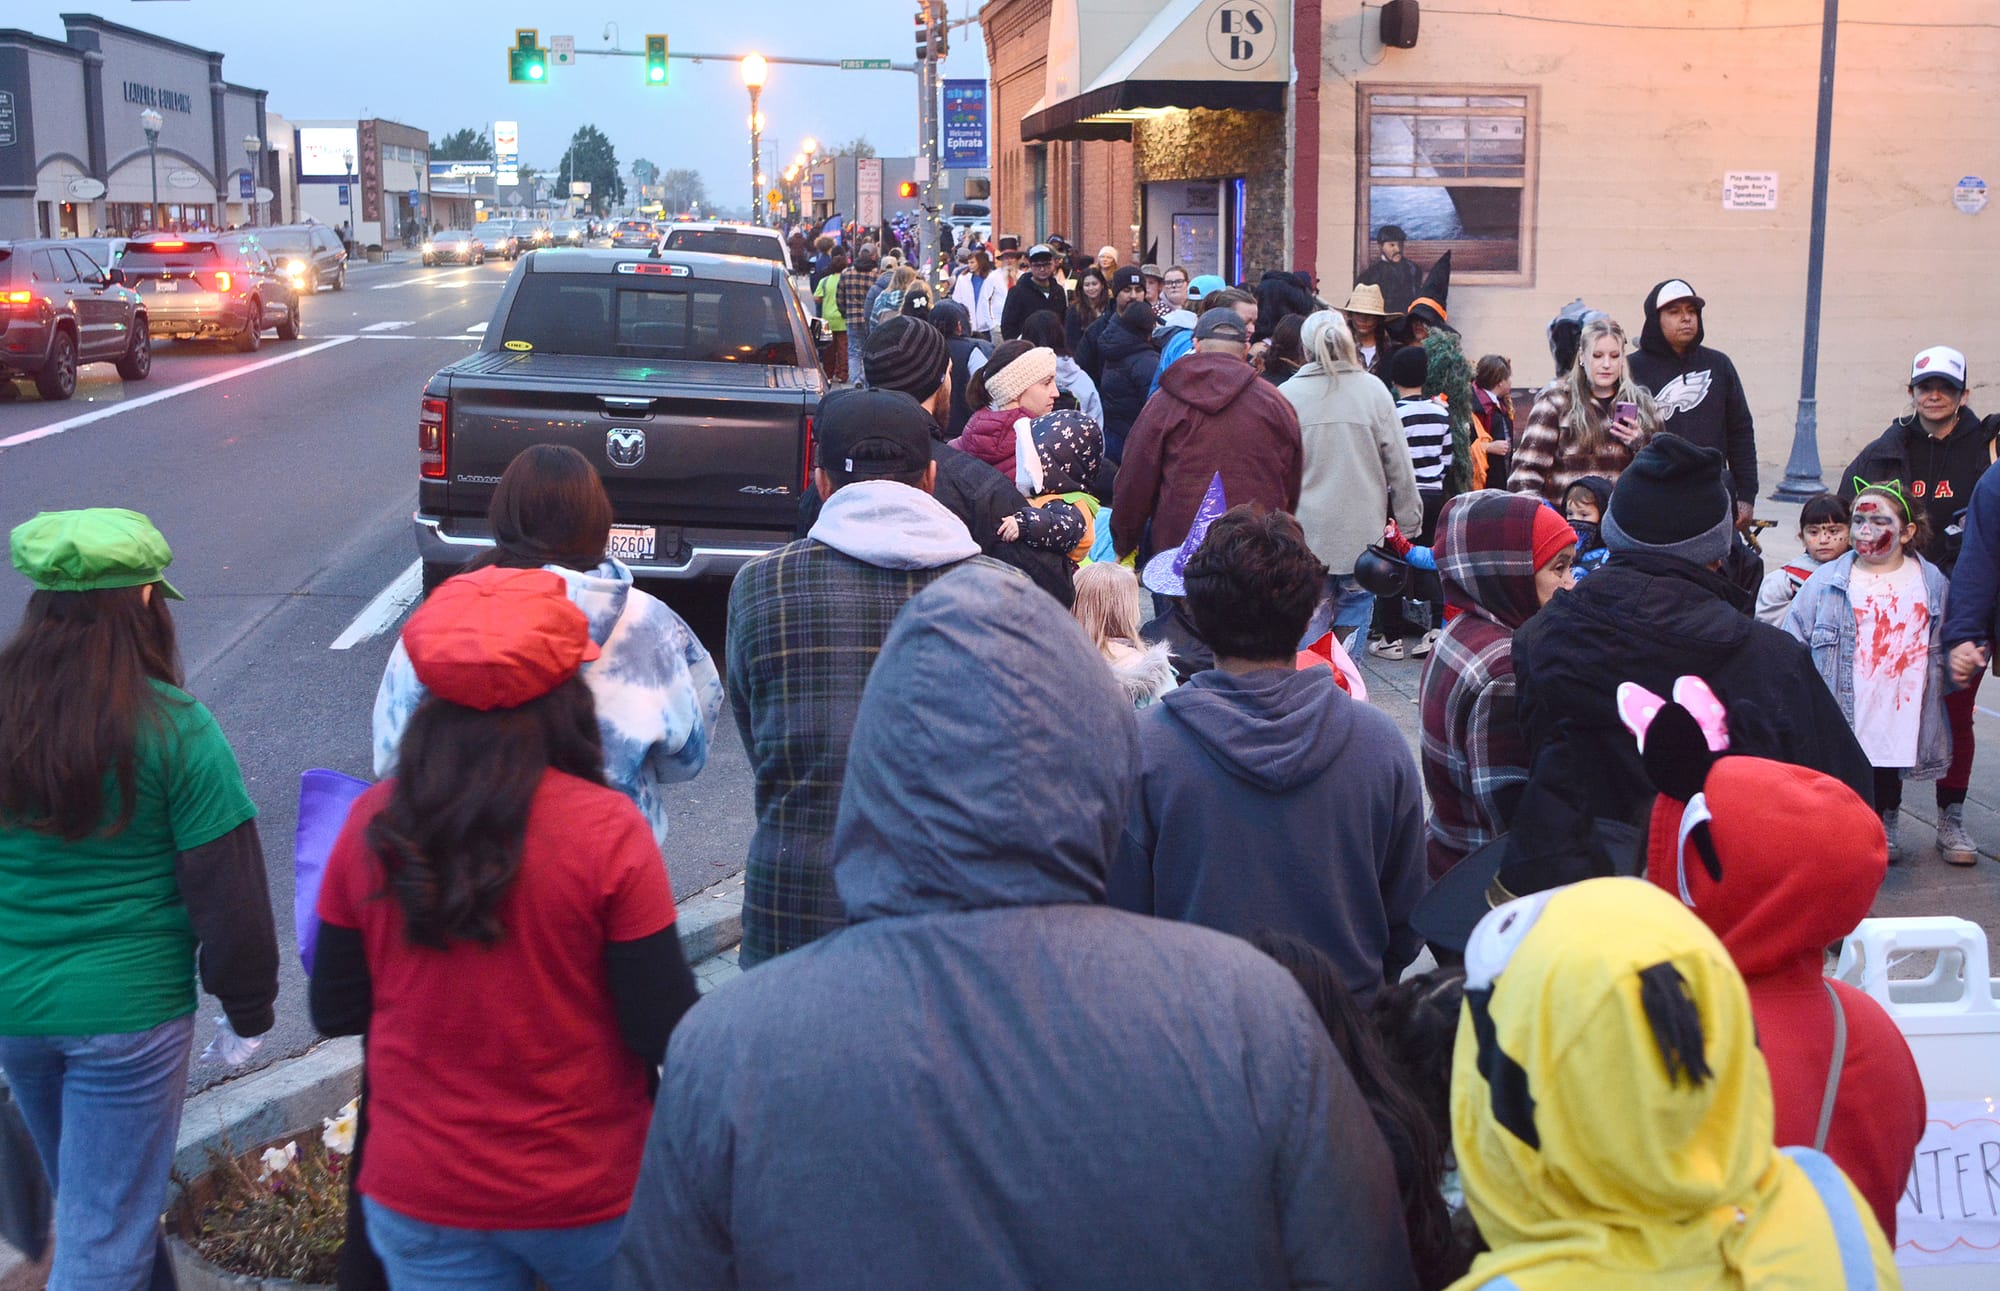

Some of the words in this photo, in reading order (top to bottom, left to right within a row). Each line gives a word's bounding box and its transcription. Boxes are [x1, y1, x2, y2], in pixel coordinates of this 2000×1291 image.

[842, 60, 865, 69] FIRST
[946, 88, 983, 99] shop
[947, 137, 983, 150] Ephrata
[457, 474, 502, 484] LARAM
[608, 536, 654, 554] 6260Y
